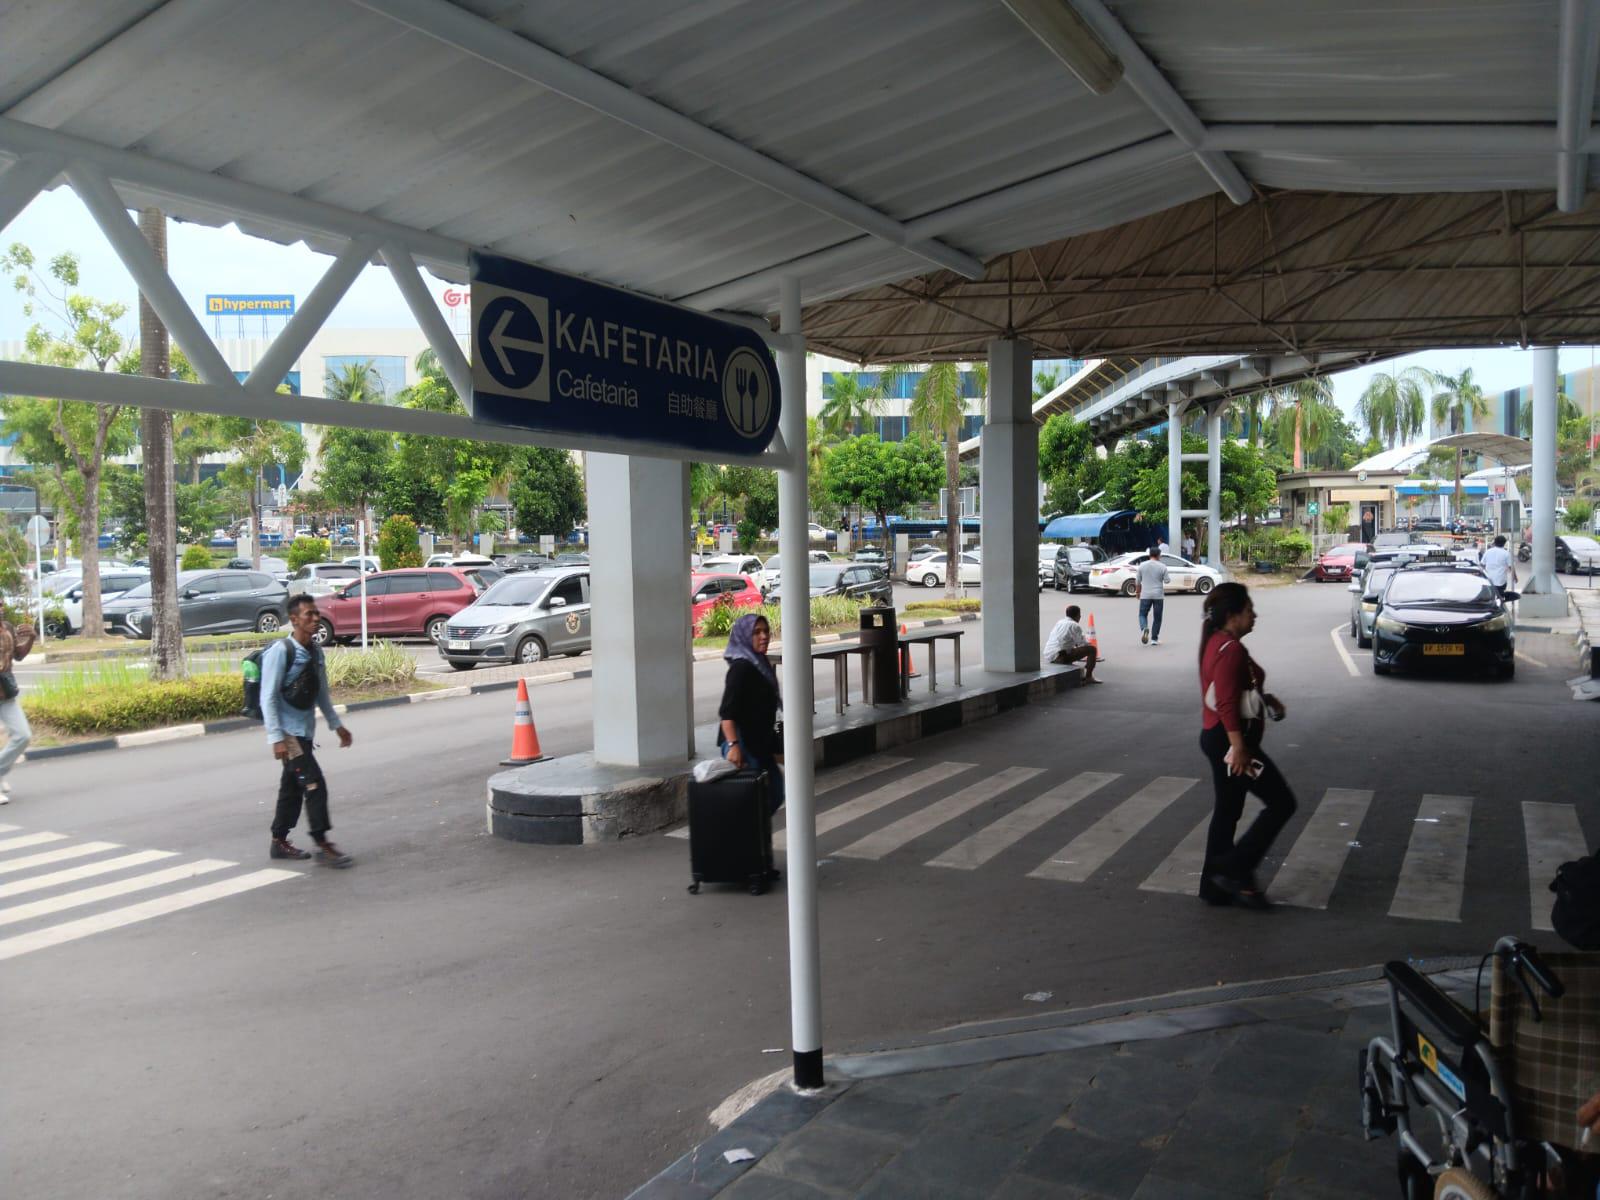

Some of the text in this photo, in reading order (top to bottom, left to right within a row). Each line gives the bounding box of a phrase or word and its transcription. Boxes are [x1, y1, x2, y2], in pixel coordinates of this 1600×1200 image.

[223, 297, 291, 311] hypermart
[555, 308, 718, 384] KAFETARIA
[556, 368, 639, 409] Cafetaria
[667, 391, 719, 421] 自助餐廳
